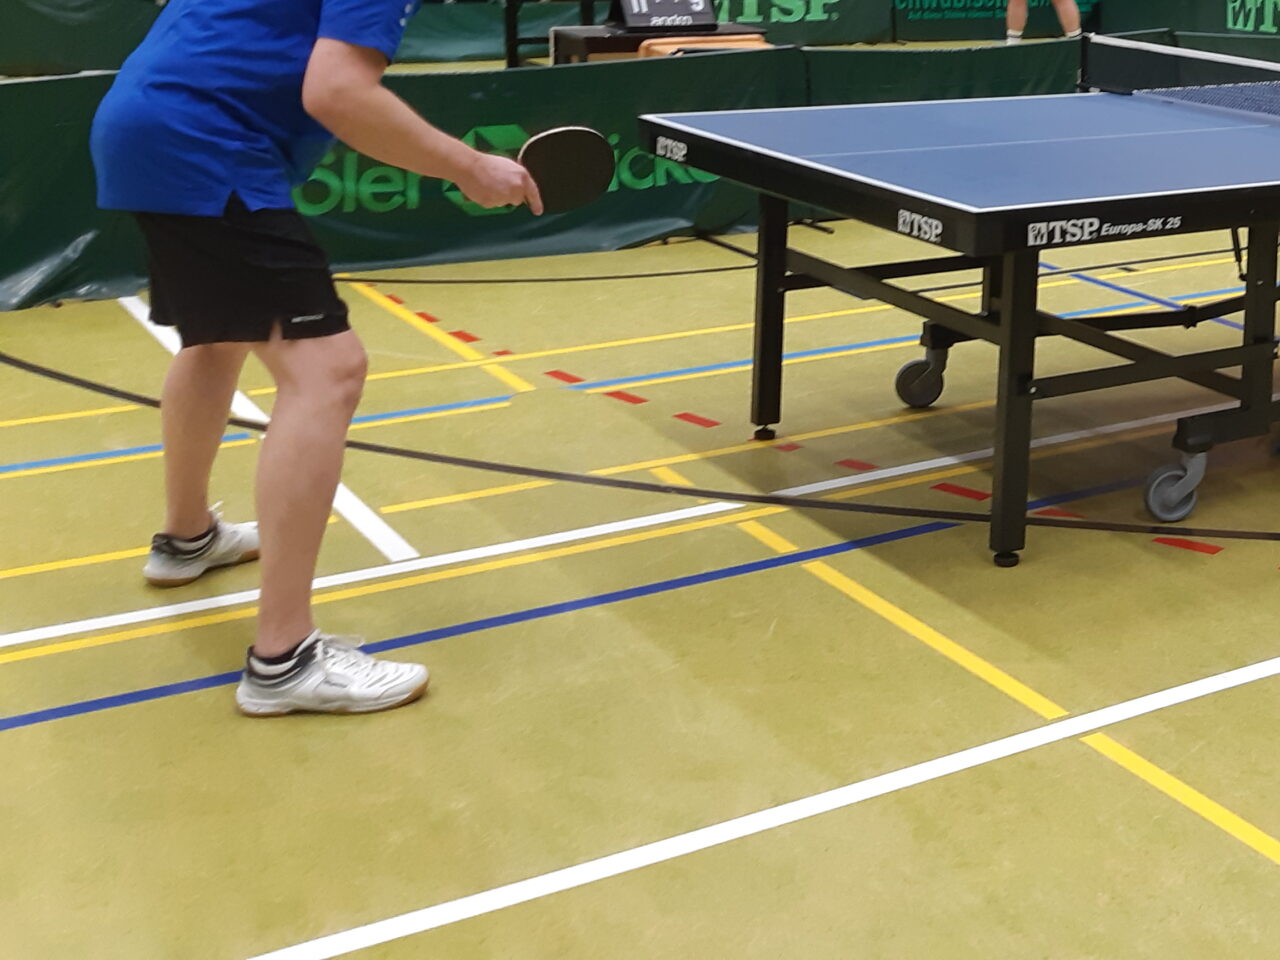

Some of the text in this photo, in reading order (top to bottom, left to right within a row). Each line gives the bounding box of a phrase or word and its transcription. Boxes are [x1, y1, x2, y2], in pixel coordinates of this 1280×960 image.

[291, 133, 720, 217] öler ick
[1100, 217, 1165, 237] Europa-SK
[1164, 216, 1182, 230] 25
